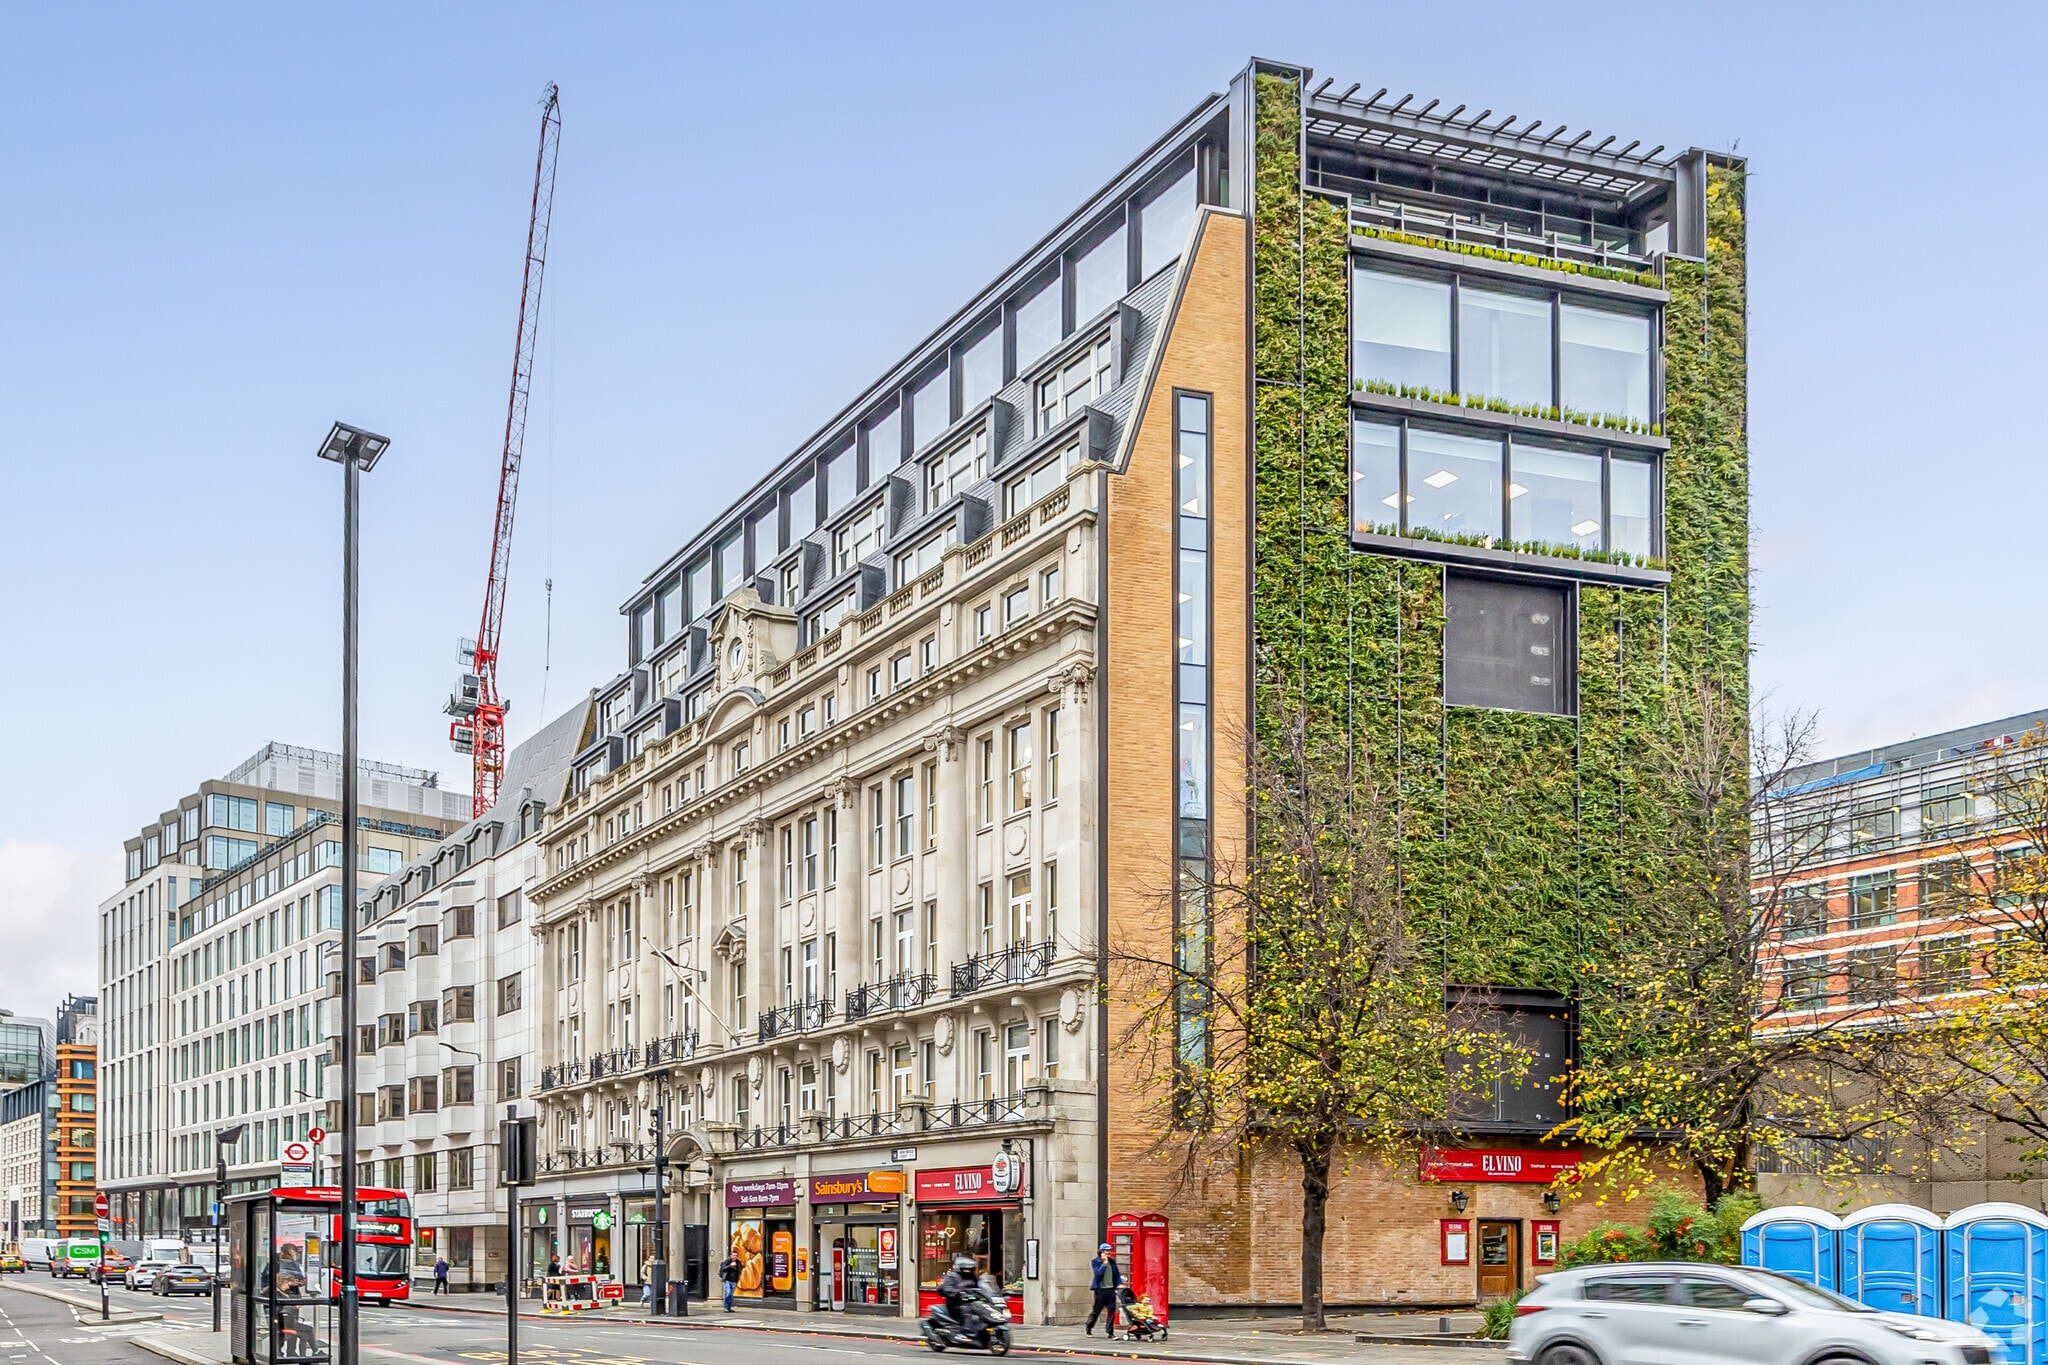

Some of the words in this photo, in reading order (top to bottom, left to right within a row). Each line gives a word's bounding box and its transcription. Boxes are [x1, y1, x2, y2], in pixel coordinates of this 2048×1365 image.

[312, 1129, 321, 1141] J
[1482, 1155, 1496, 1172] EL
[1496, 1155, 1522, 1172] VINO
[954, 1174, 964, 1190] EL
[964, 1172, 982, 1190] VINO
[731, 1184, 744, 1194] Open
[743, 1182, 766, 1193] weekdays
[814, 1179, 863, 1197] Sainsbury's
[740, 1195, 758, 1204] Sat-Sun
[73, 1247, 96, 1255] CSM
